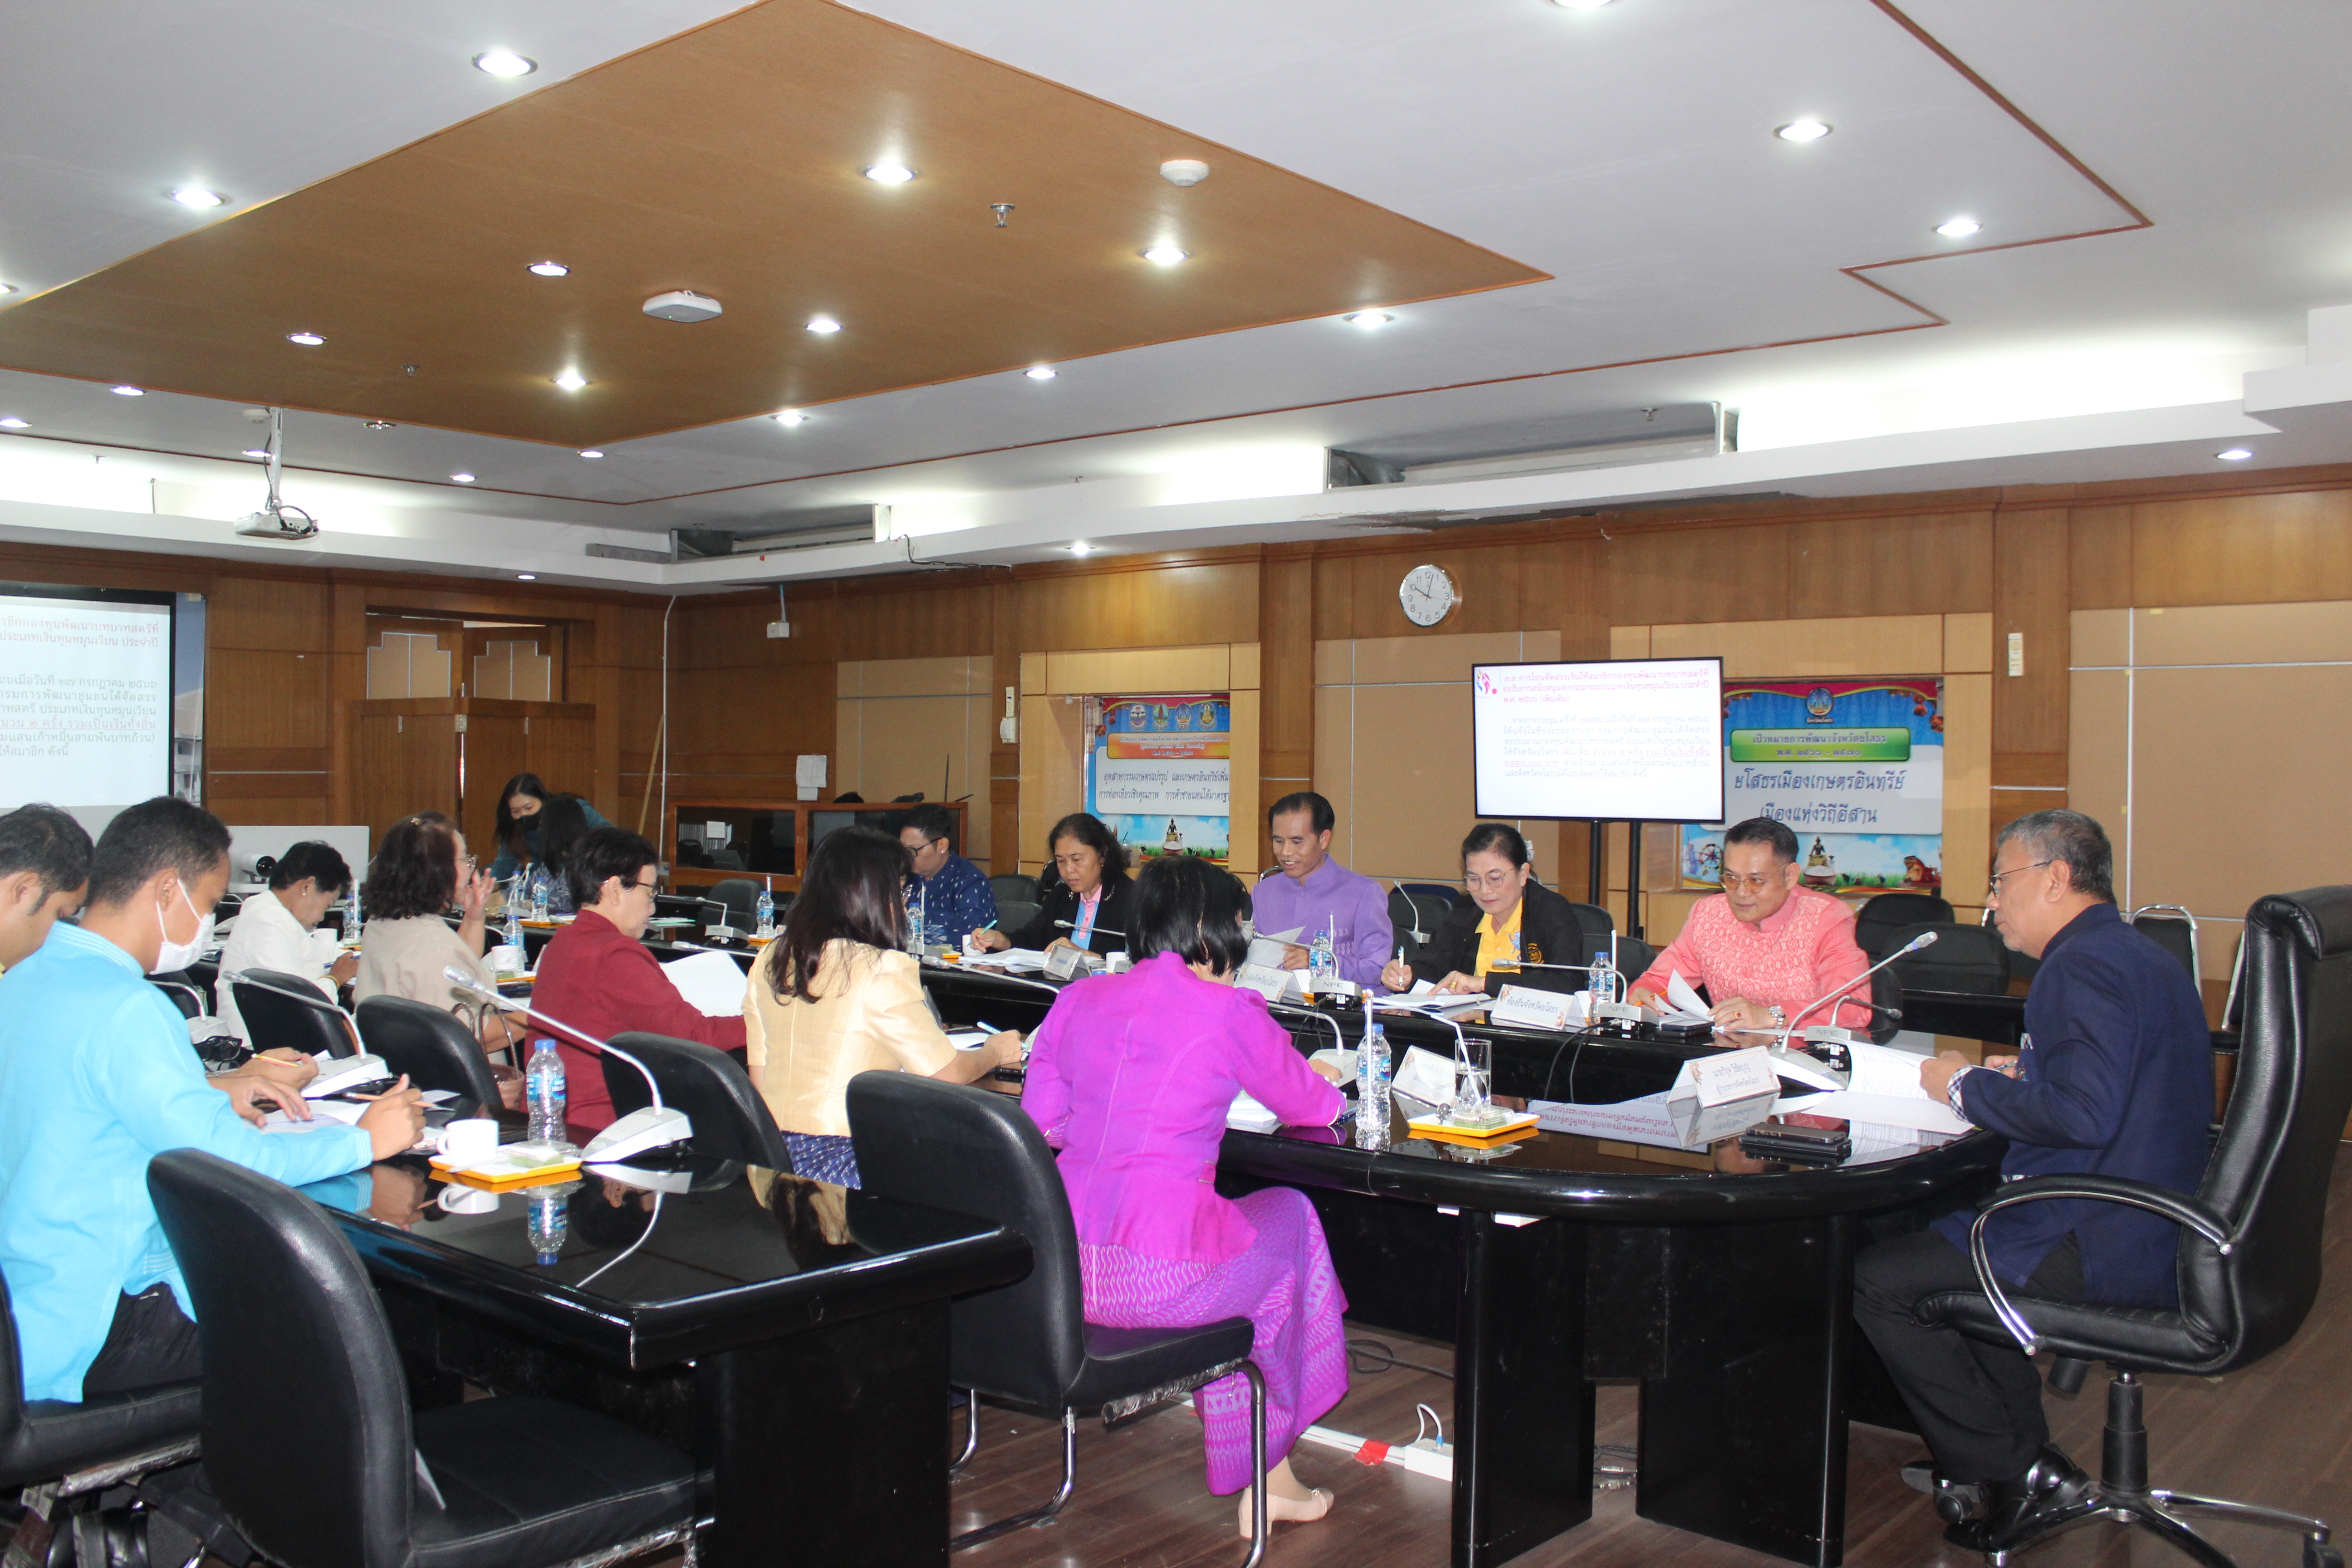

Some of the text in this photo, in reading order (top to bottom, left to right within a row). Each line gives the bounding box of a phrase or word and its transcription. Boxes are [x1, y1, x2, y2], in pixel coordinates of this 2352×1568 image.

[0, 615, 159, 634] าชิกกองทุนพัฒนาบทบาทสตรีที่
[0, 630, 159, 648] ประเภทเงินทุนหมุนเวียน ประจำปี
[0, 671, 157, 690] ๖๖เมื่อวันที่ ๒๗ กรกฎาคม ๒๕๖๖
[1681, 679, 1710, 689] ประจำปี
[1539, 692, 1570, 704] (เพิ่มเติม)
[0, 702, 157, 718] าทสตรี ประเภทเงินทุนหมุนเวียน
[0, 714, 156, 730] นวน ๒ ครั้ง รวมเป็นเงินทั้งสิ้น
[1512, 716, 1558, 726] จากการประชุม
[1560, 713, 1577, 724] ครั้งที่
[1652, 716, 1685, 725] กรกฎาคม
[0, 730, 156, 745] มแสนเก้าหมื่นสามพันบาทถ้วน)
[1753, 731, 1887, 744] เป้าหมายการพัฒนาจังหวัดยโสธร
[48, 741, 69, 756] ดังนี้
[1504, 746, 1558, 756] ให้จังหวัดยโสธร
[1562, 746, 1589, 756] เพิ่มเติม
[1592, 748, 1616, 756] จำนวน
[1628, 745, 1642, 756] ครั้ง
[1104, 767, 1230, 785] อุตสาหกรรมเกษตรแปรรูป และเกษตรอินทรีย์เพิ่ม
[1633, 767, 1647, 778] ดังนี้
[1735, 769, 1907, 791] ยโสธรเมืองเกษตรอินทรีย์
[1099, 784, 1230, 803] การท่องเที่ยวเชิงคุณภาพ การค้าชายแดนได้มาตรฐา
[1760, 802, 1878, 824] เมืองแห่งวิถีอีสาน
[1506, 996, 1559, 1013] ท้องถิ่นจังหวัดยโสธร
